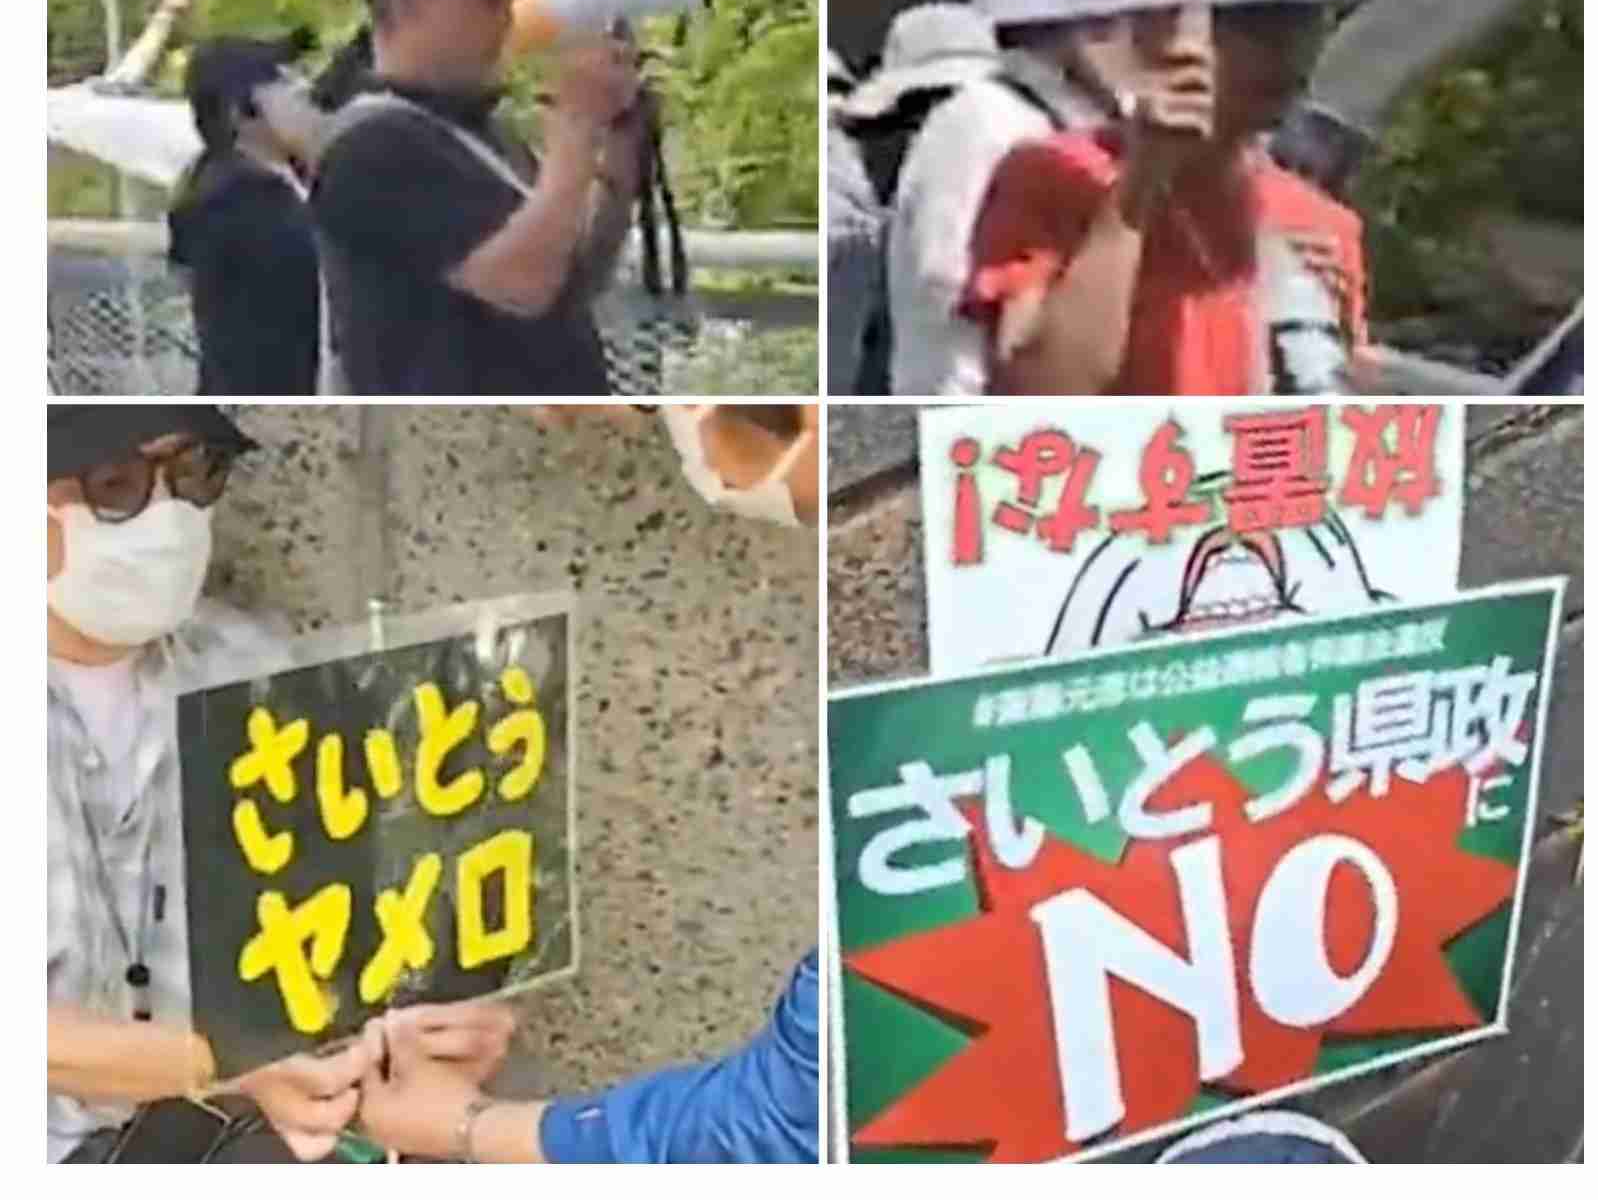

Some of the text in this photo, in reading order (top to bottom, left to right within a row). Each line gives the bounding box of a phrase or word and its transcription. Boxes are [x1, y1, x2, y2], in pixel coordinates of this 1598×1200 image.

[228, 666, 548, 875] さいとう
[238, 828, 535, 1036] ヤメロ
[1029, 833, 1400, 1145] NO
